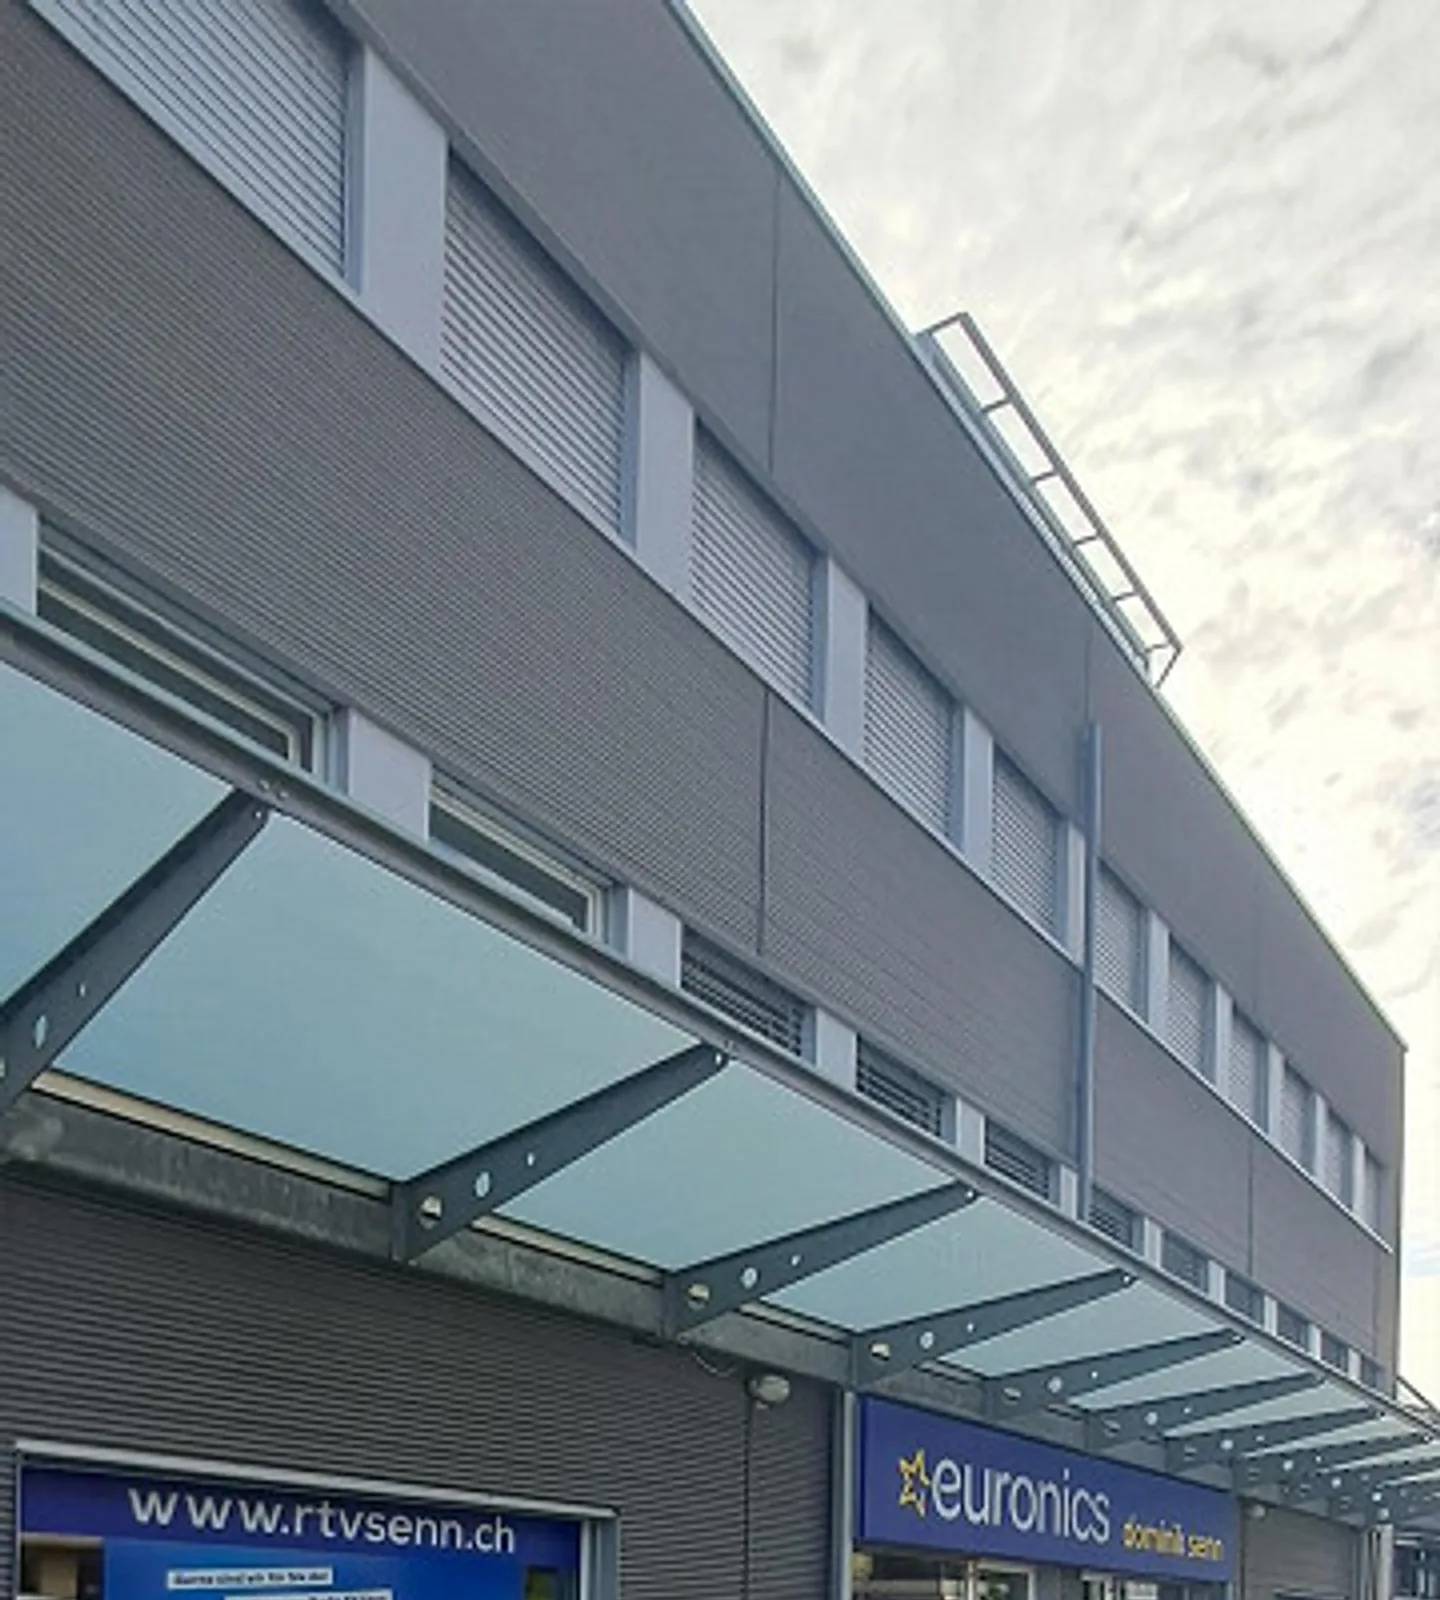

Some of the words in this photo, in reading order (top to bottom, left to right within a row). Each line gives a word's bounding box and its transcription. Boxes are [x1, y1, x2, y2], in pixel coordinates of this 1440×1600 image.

[128, 1487, 515, 1553] www.rtvsenn.ch
[931, 1458, 1111, 1543] euronics
[1123, 1516, 1186, 1555] dominik
[1187, 1531, 1223, 1561] senn
